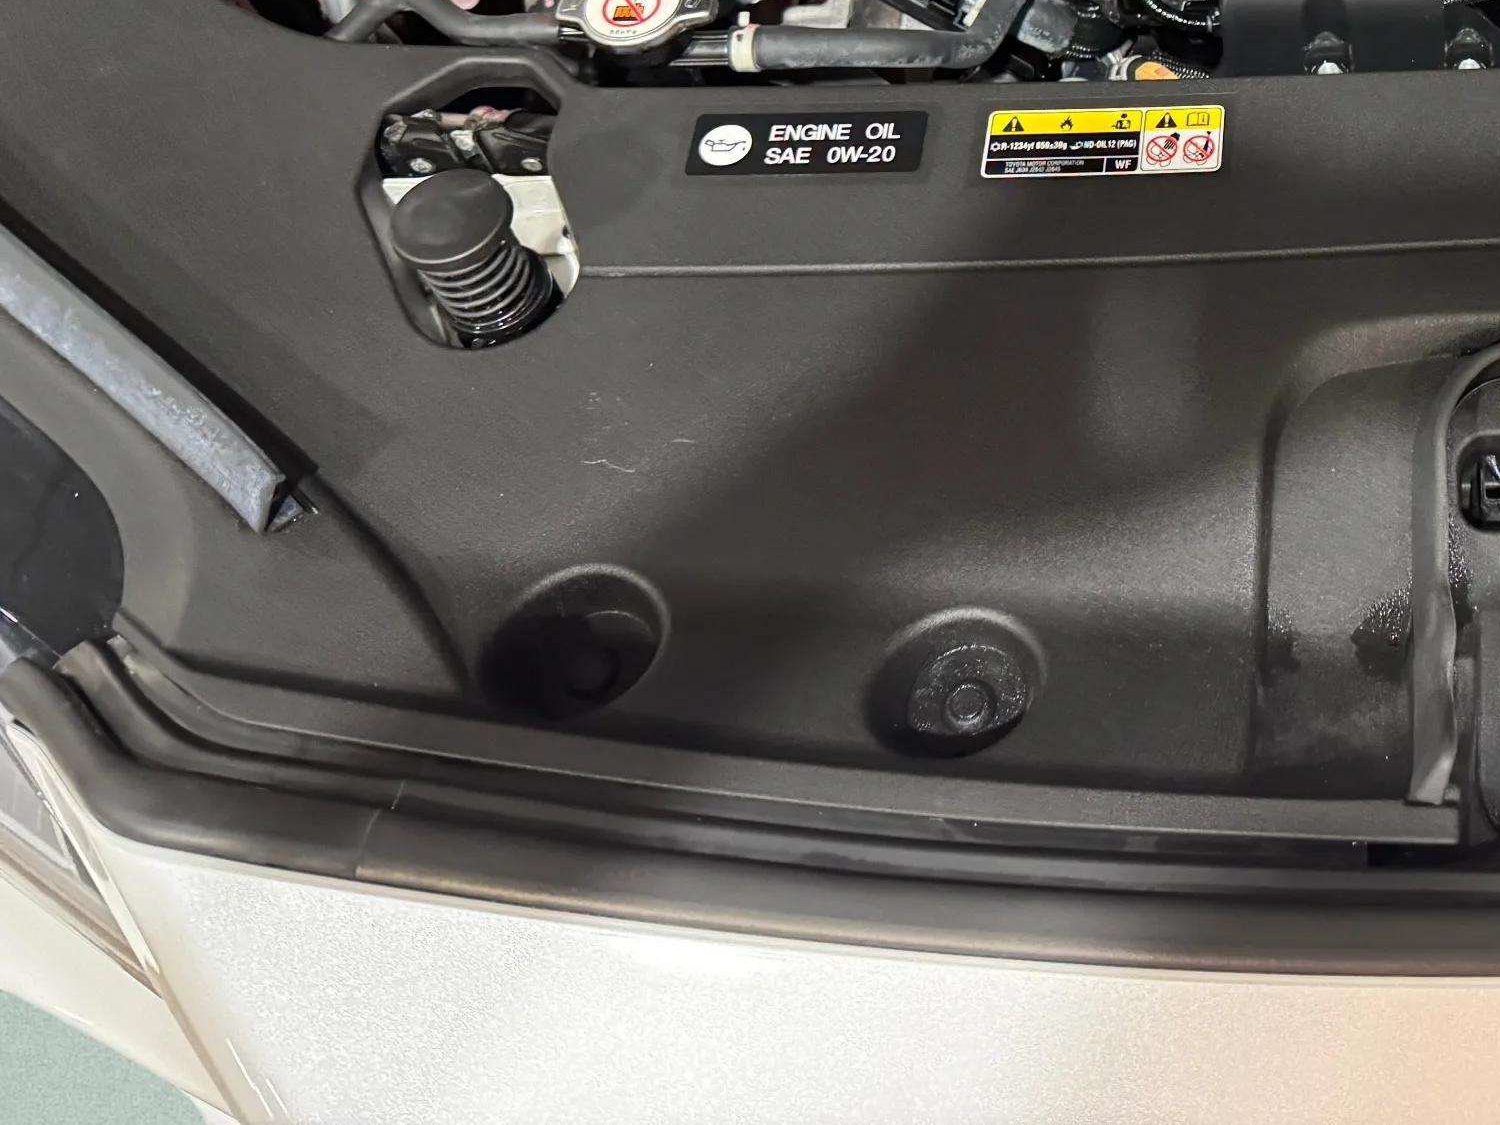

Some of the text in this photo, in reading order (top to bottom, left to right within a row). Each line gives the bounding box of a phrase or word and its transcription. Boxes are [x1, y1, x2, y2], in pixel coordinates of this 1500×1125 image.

[768, 122, 901, 142] ENGINE OIL
[763, 145, 896, 165] SAE 0W-20
[1114, 159, 1132, 169] WF
